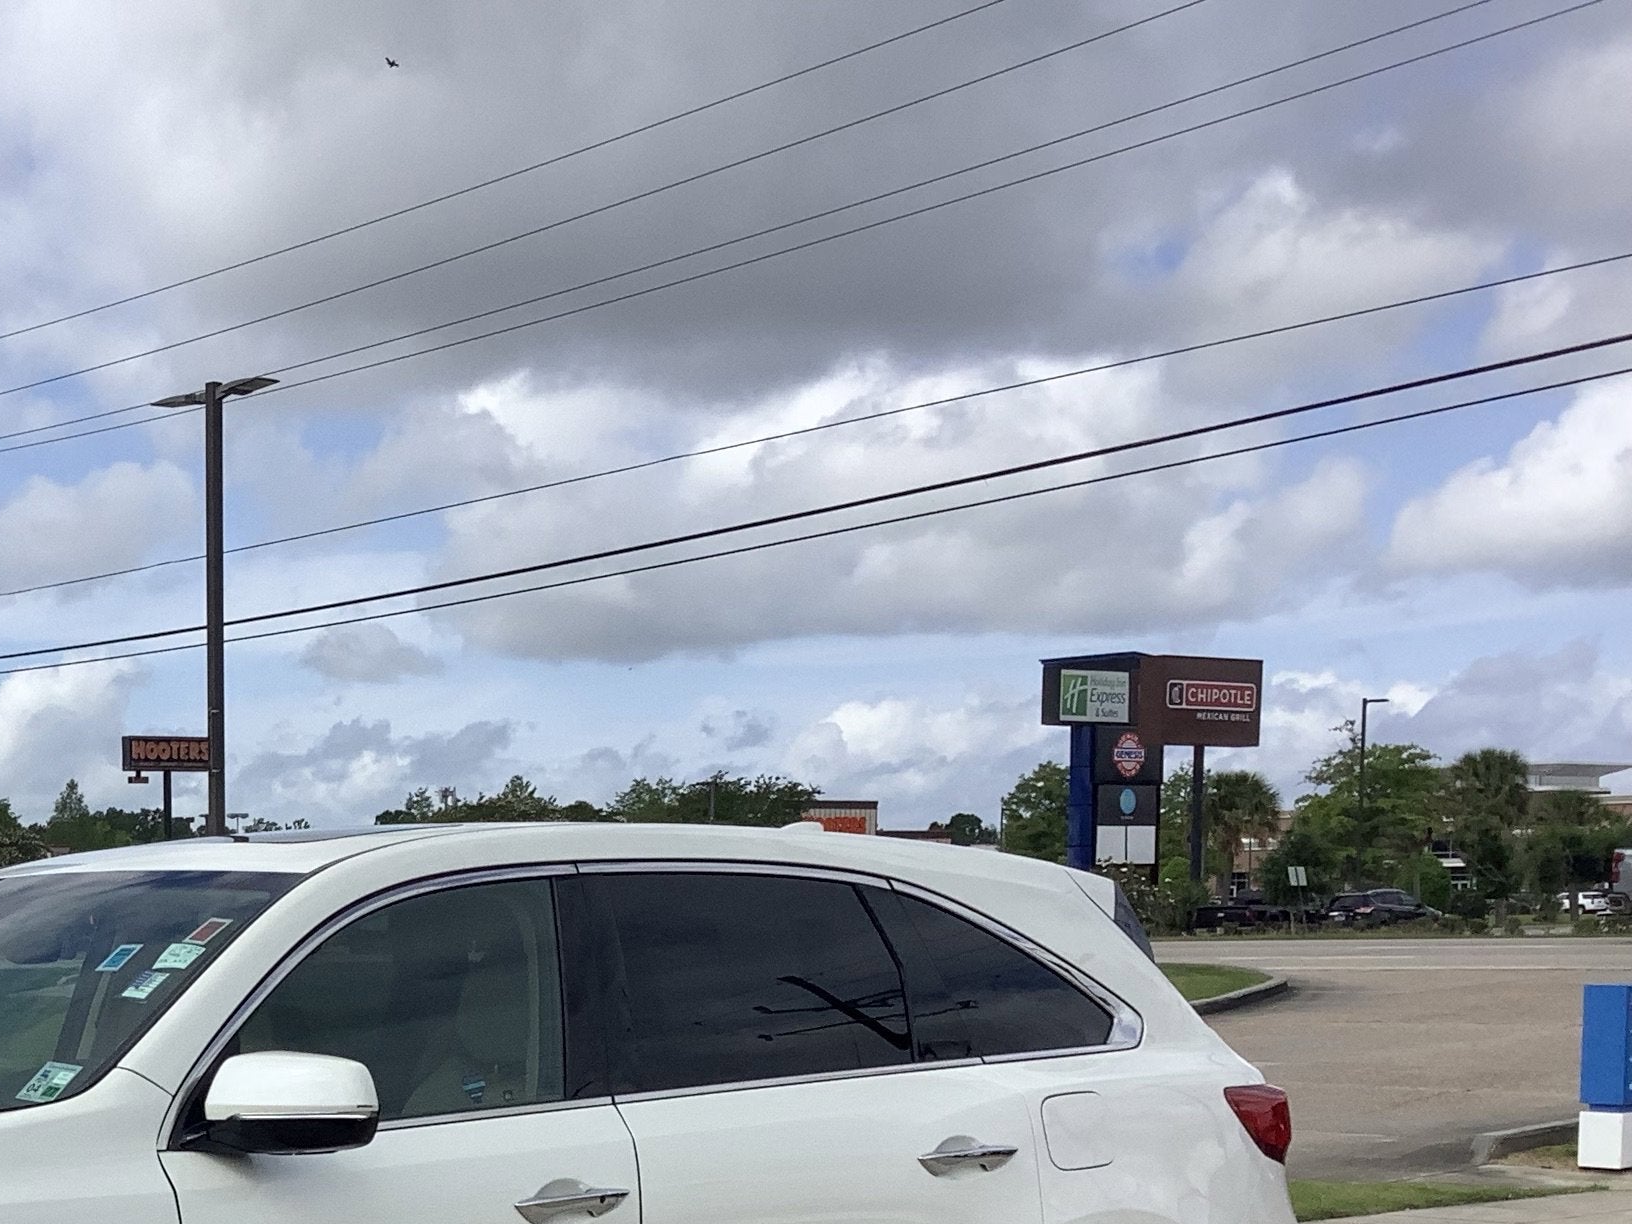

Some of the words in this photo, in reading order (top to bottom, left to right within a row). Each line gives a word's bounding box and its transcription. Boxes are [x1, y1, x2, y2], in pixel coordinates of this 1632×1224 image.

[1089, 688, 1126, 706] Express
[1188, 688, 1252, 704] CHIPOTLE
[1196, 712, 1229, 721] MEXICAN
[1230, 713, 1250, 722] GRILL
[131, 740, 208, 760] HOOTERS
